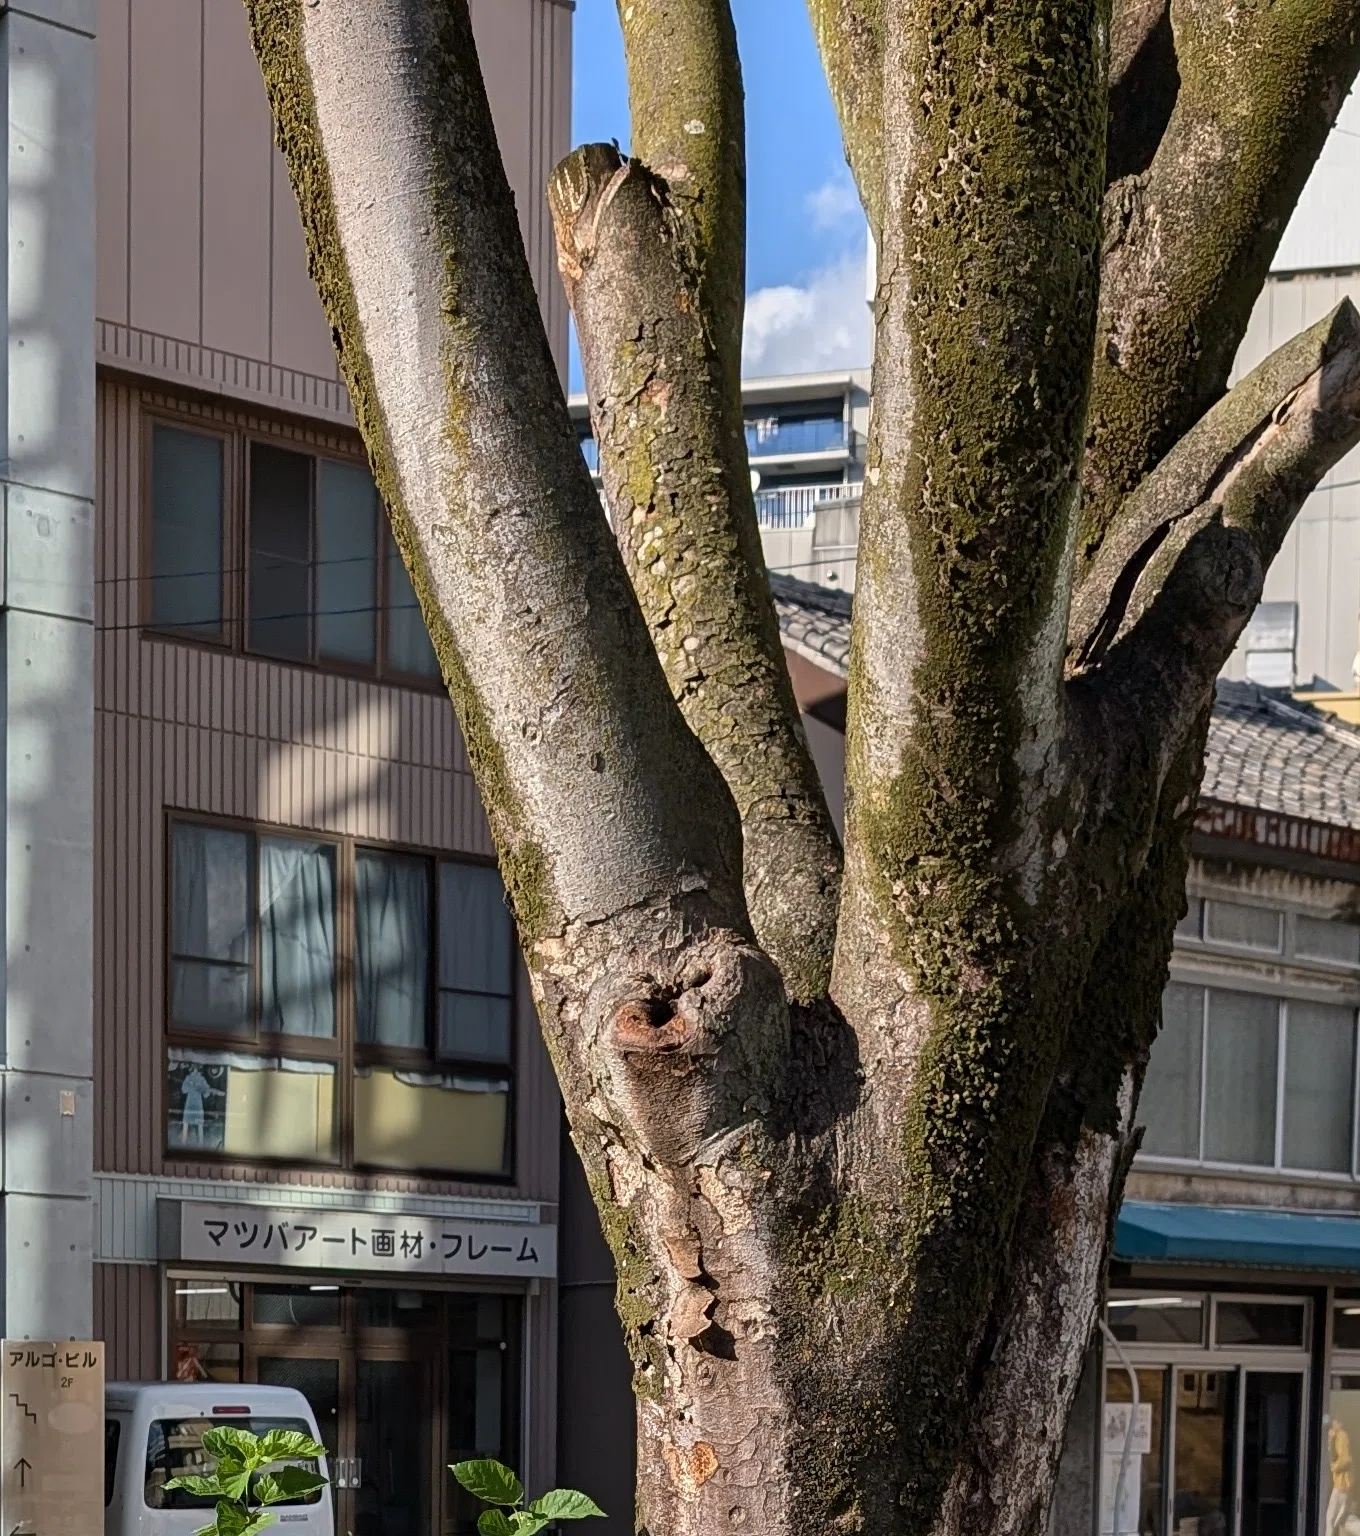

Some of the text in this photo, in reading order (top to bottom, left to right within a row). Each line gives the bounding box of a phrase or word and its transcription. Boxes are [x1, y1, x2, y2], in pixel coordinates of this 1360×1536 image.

[203, 1219, 540, 1263] マツバアート画材・フレーム
[9, 1351, 97, 1368] アルゴ・ビル
[60, 1376, 74, 1389] 2F
